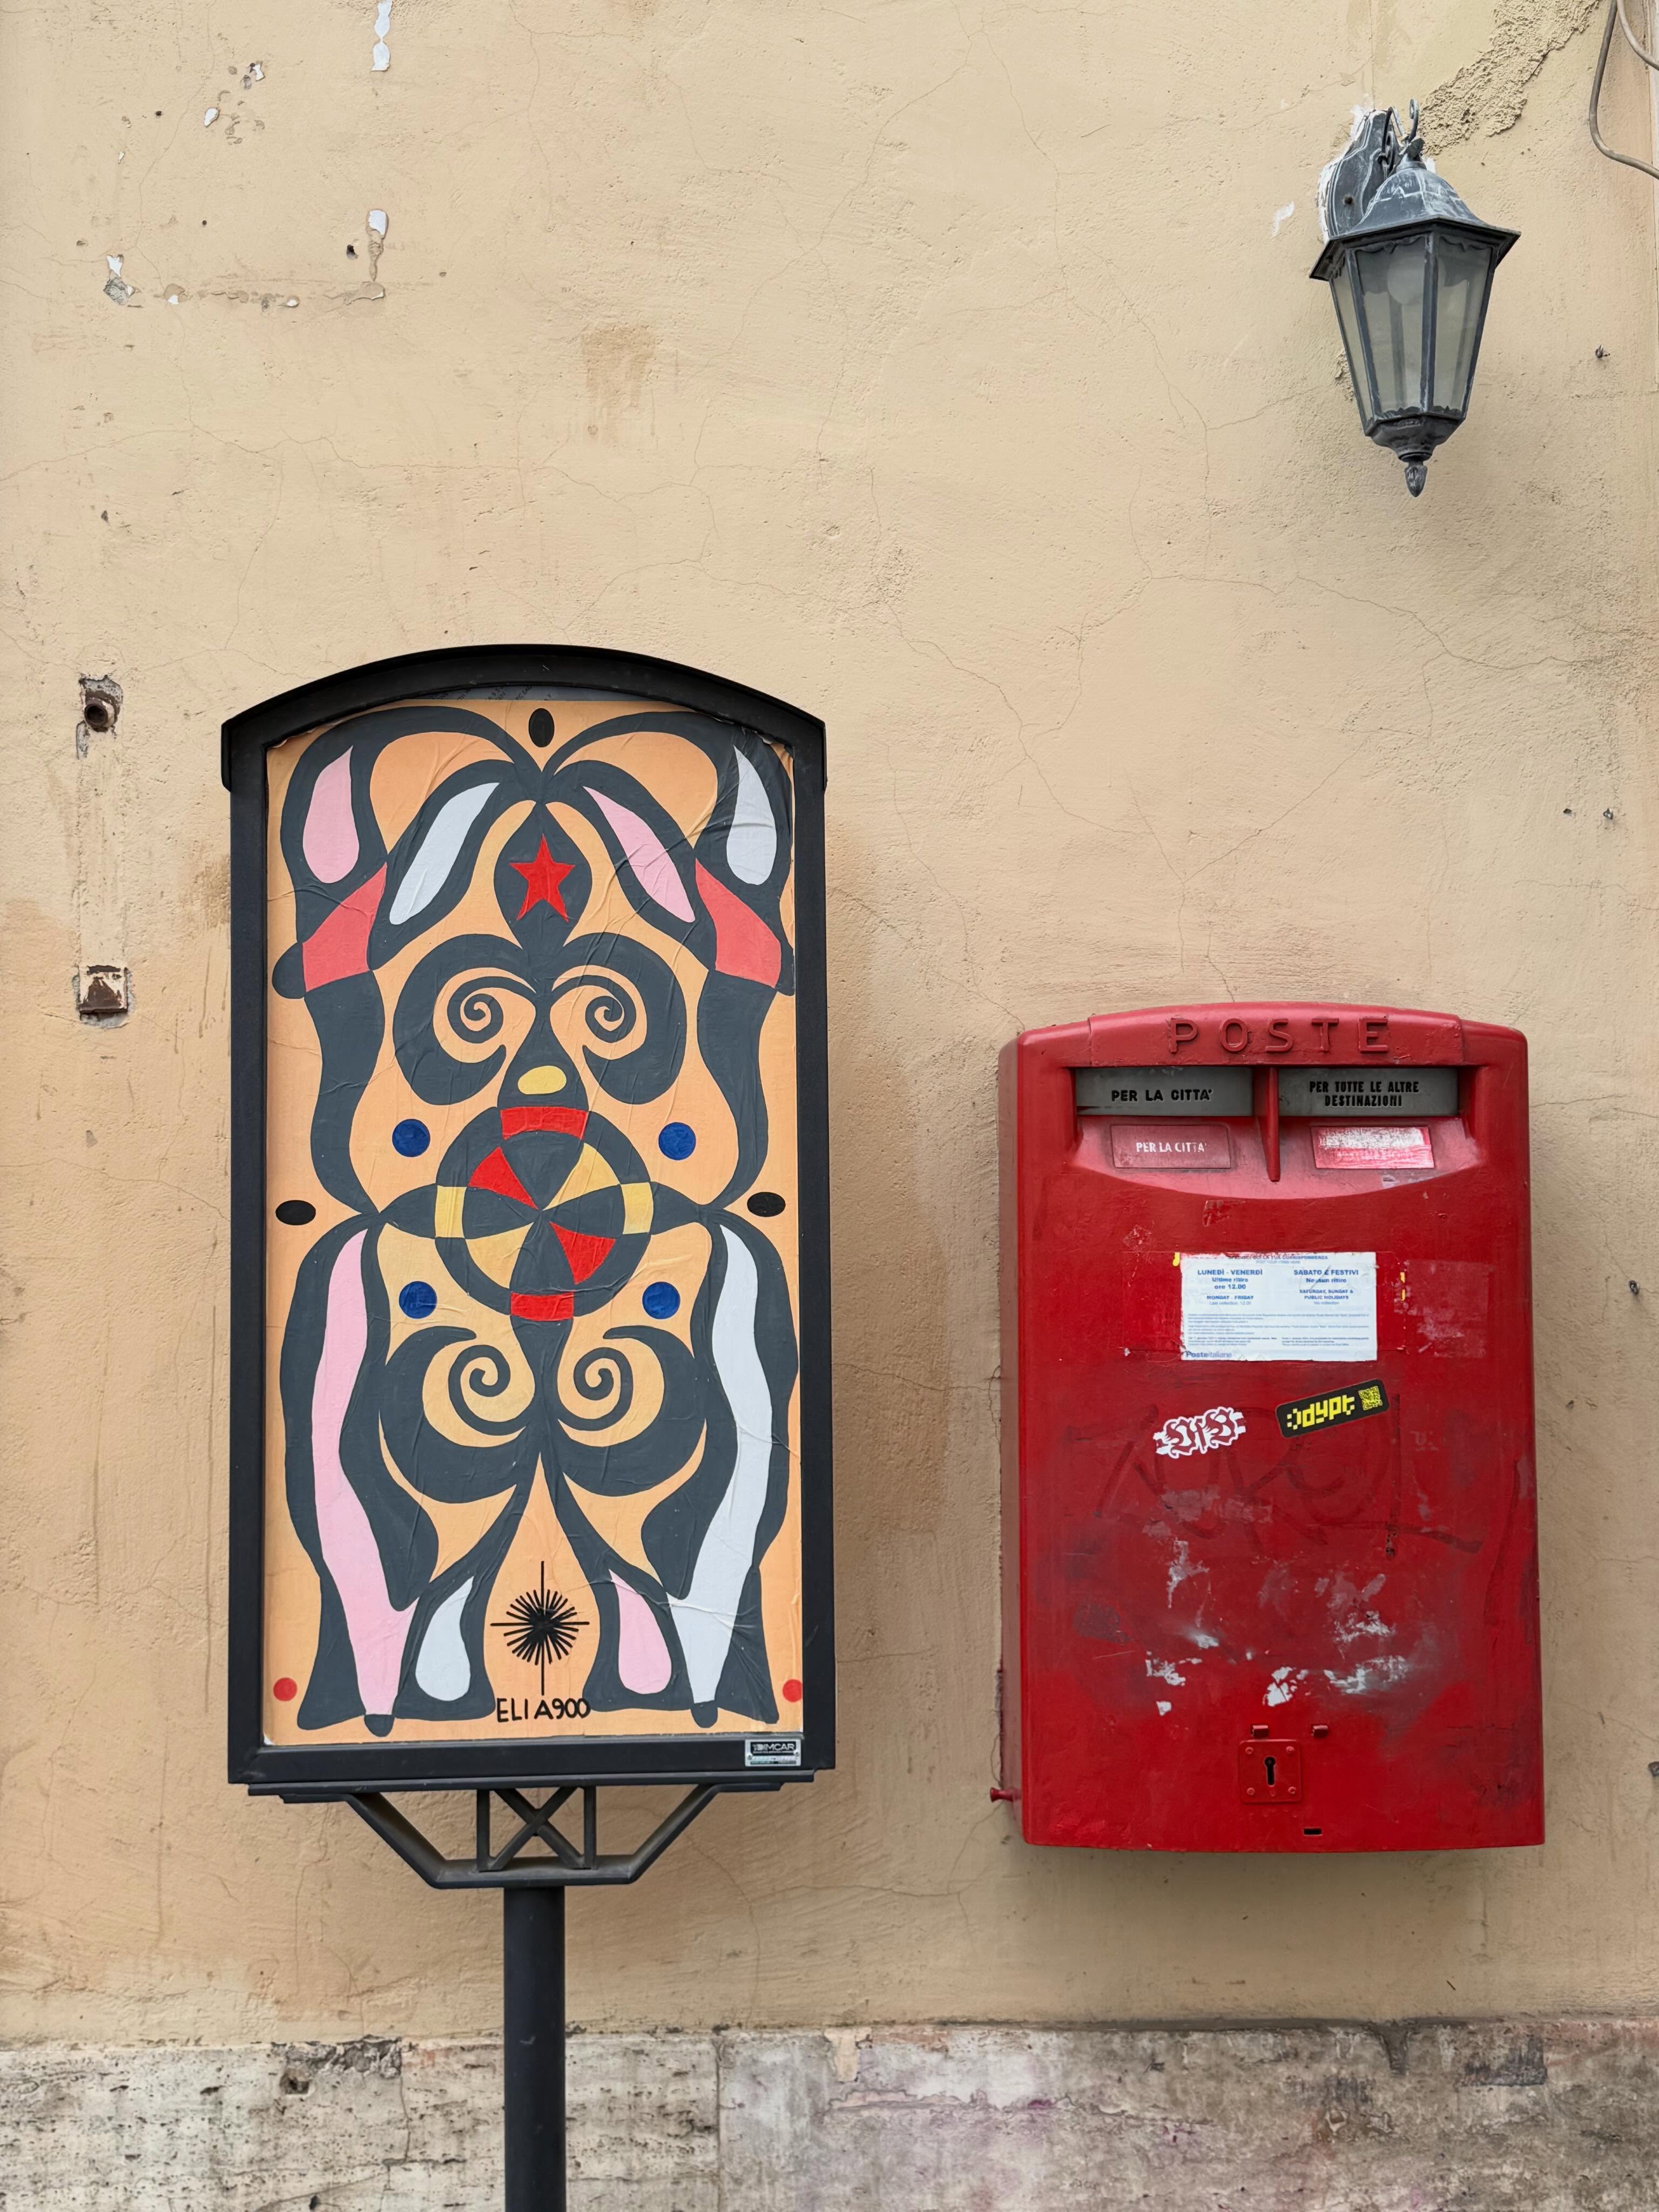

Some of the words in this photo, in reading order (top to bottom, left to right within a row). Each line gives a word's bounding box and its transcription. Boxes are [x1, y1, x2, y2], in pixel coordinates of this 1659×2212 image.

[1169, 1017, 1388, 1053] POSTE
[1309, 1081, 1329, 1092] PER
[1335, 1081, 1364, 1092] TUTTE
[1370, 1081, 1382, 1092] LE
[1387, 1081, 1419, 1092] ALTRE
[1111, 1090, 1137, 1101] PER
[1145, 1089, 1163, 1101] LA
[1325, 1095, 1402, 1107] DESTINAZIONI
[1136, 1142, 1157, 1152] PER
[1159, 1142, 1172, 1152] LA
